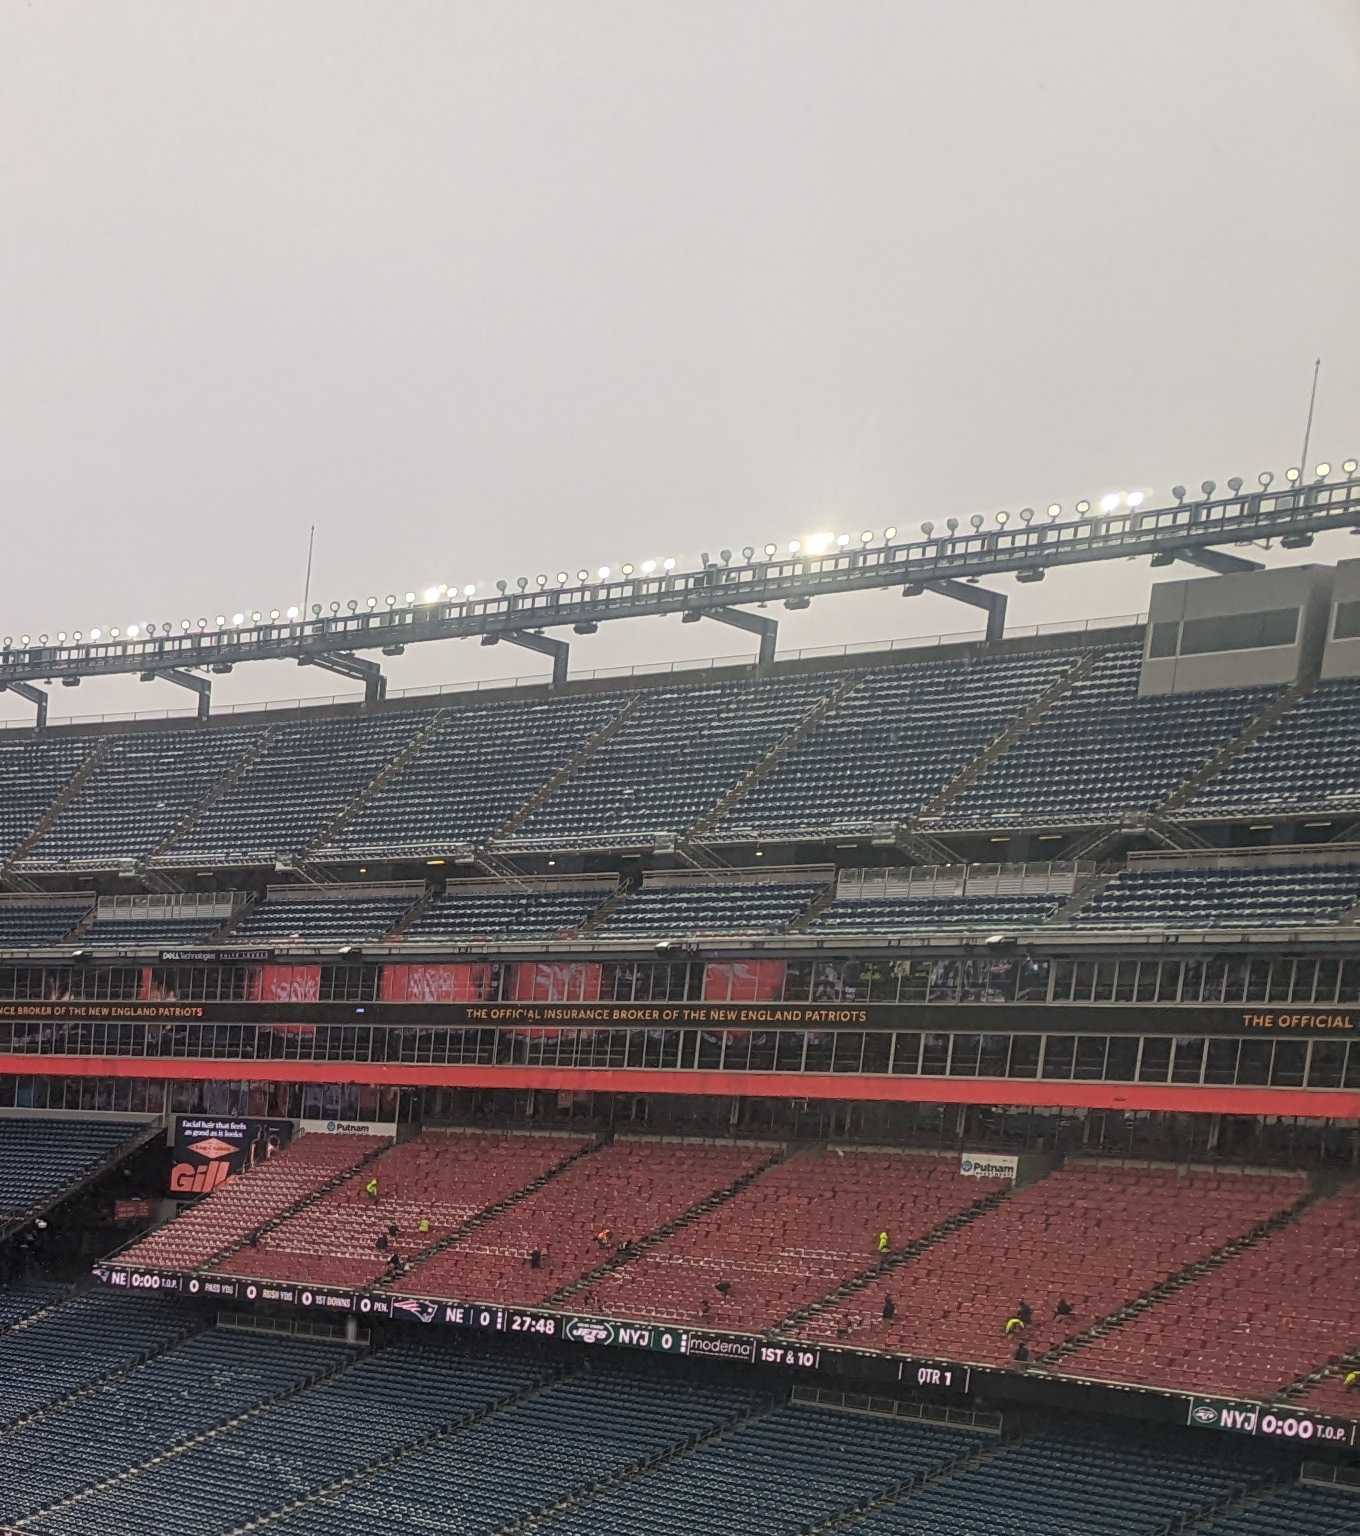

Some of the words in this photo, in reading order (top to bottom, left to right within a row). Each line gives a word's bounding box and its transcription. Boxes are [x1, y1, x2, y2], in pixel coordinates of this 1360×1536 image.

[17, 1006, 52, 1017] BROKER
[53, 1007, 66, 1017] OF
[68, 1007, 86, 1017] THE
[87, 1007, 109, 1018] NEW
[111, 1007, 156, 1018] ENGLAND
[158, 1007, 204, 1018] PATRIOTS
[466, 1008, 487, 1019] THE
[543, 1009, 610, 1020] INSURANCE
[612, 1009, 660, 1021] BROKER
[662, 1010, 679, 1021] OF
[682, 1010, 707, 1021] THE
[709, 1010, 739, 1021] NEW
[742, 1010, 802, 1022] ENGLAND
[805, 1010, 867, 1022] PATRIOTS
[1242, 1015, 1274, 1027] THE
[1278, 1015, 1354, 1028] OFFICIAL
[336, 1123, 370, 1133] Putnam
[974, 1162, 1014, 1174] Putnam
[111, 1273, 126, 1286] NE
[132, 1274, 160, 1289] 0:00
[446, 1308, 464, 1323] NE
[479, 1311, 490, 1326] 0
[511, 1315, 555, 1335] 27:48
[618, 1328, 649, 1346] NYJ
[661, 1334, 672, 1350] 0
[690, 1335, 751, 1355] moderna
[760, 1348, 784, 1366] 1ST
[786, 1351, 796, 1367] &
[798, 1352, 814, 1368] 10
[917, 1368, 940, 1387] QTR
[943, 1370, 952, 1387] 1
[1220, 1408, 1256, 1431] NYJ
[1261, 1414, 1314, 1440] 0:00
[1316, 1424, 1347, 1441] T.O.P.
